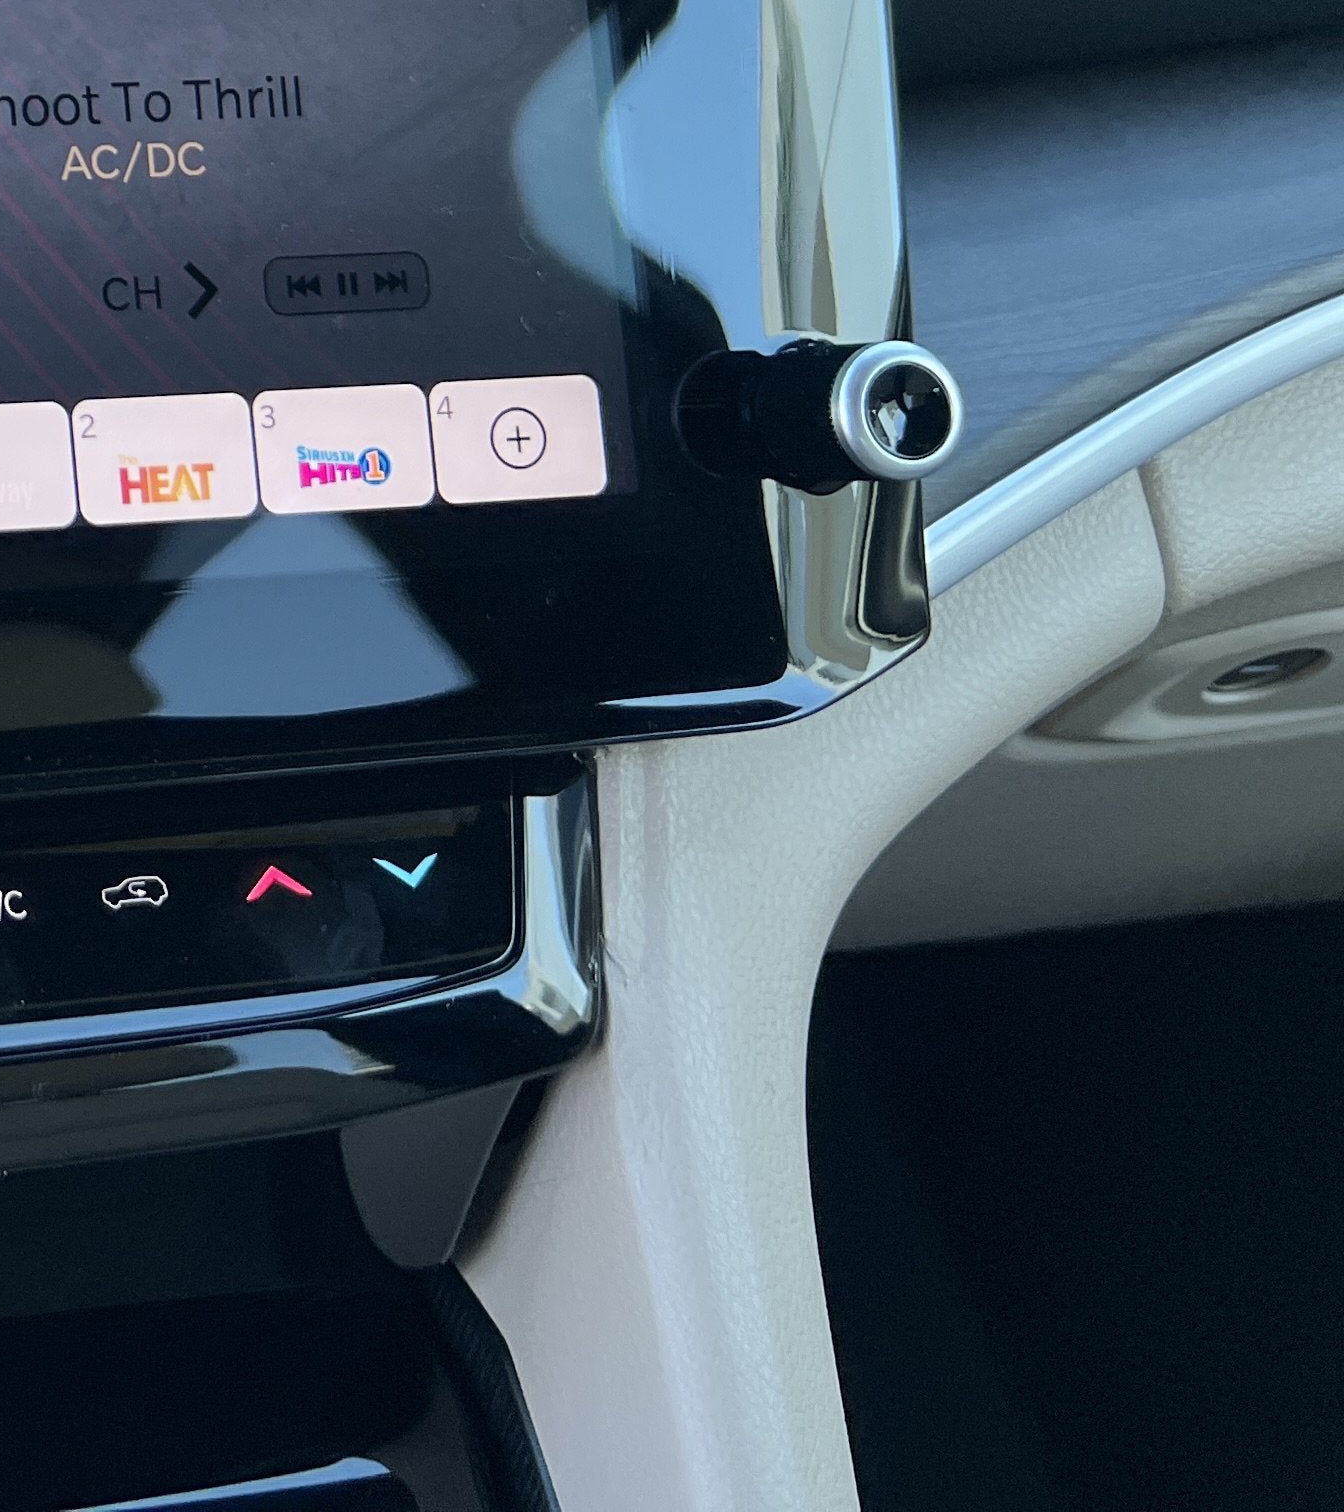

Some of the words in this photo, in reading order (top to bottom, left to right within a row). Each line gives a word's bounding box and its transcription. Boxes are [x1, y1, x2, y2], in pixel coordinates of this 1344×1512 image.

[111, 80, 176, 126] To
[184, 74, 305, 123] Thrill
[60, 142, 207, 186] AC/DC
[100, 275, 163, 312] CH
[260, 404, 277, 429] 3
[436, 395, 454, 420] 4
[79, 413, 97, 439] 2
[365, 449, 386, 481] 1
[119, 462, 214, 504] HEAT
